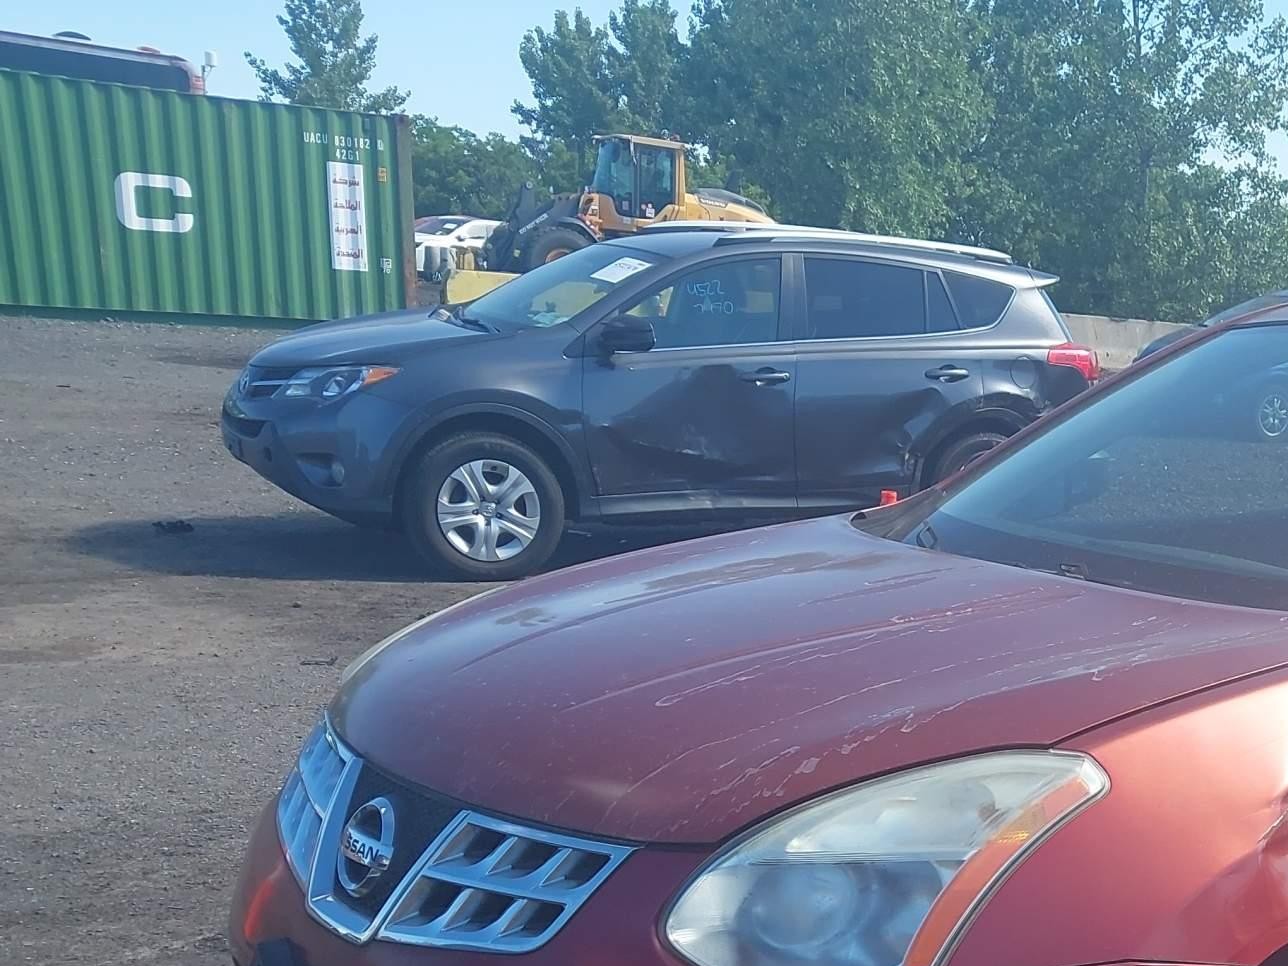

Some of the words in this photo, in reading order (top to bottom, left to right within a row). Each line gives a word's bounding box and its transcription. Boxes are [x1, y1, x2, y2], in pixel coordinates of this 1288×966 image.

[303, 131, 328, 144] UACU
[334, 135, 371, 149] 830182
[114, 171, 194, 233] C
